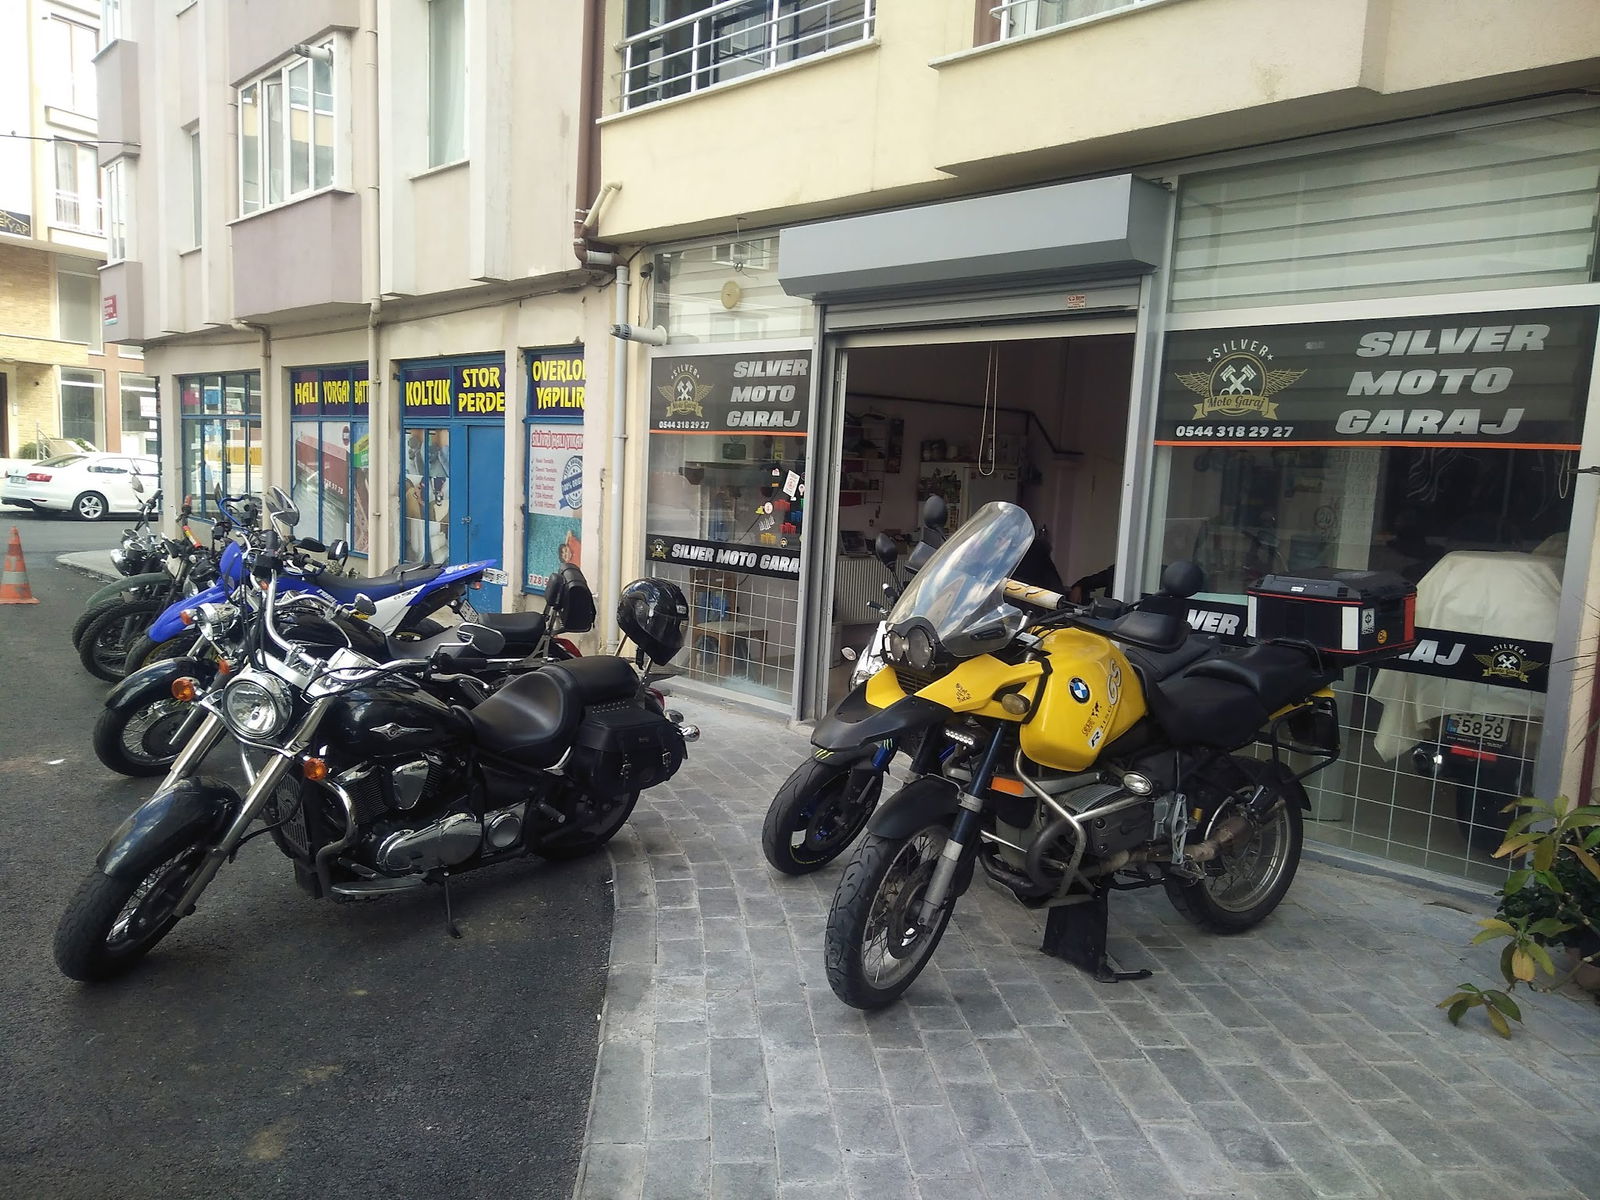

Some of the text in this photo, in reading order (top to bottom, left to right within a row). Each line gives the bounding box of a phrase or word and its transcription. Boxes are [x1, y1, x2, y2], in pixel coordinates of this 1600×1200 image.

[1212, 339, 1269, 358] SILVER
[1356, 324, 1550, 358] SILVER
[462, 367, 500, 389] STOR
[672, 363, 698, 376] SILVER
[733, 358, 809, 378] SILVER
[1347, 367, 1514, 396] MOTO
[294, 381, 319, 406] HALI
[405, 379, 450, 407] KOLTUK
[458, 391, 506, 414] PERDE
[536, 386, 586, 410] YAPILIR
[730, 385, 796, 402] MOTO
[1207, 396, 1266, 411] Moto Garaj
[658, 420, 710, 429] 0544 318 29 27
[726, 410, 801, 427] GARAJ
[1335, 408, 1525, 435] GARAJ
[1176, 425, 1294, 438] 0544 318 29 27
[671, 543, 800, 573] SILVER MOTO GARA
[1187, 609, 1240, 635] VER
[1493, 643, 1525, 655] SILVER
[1461, 718, 1504, 739] 5829
